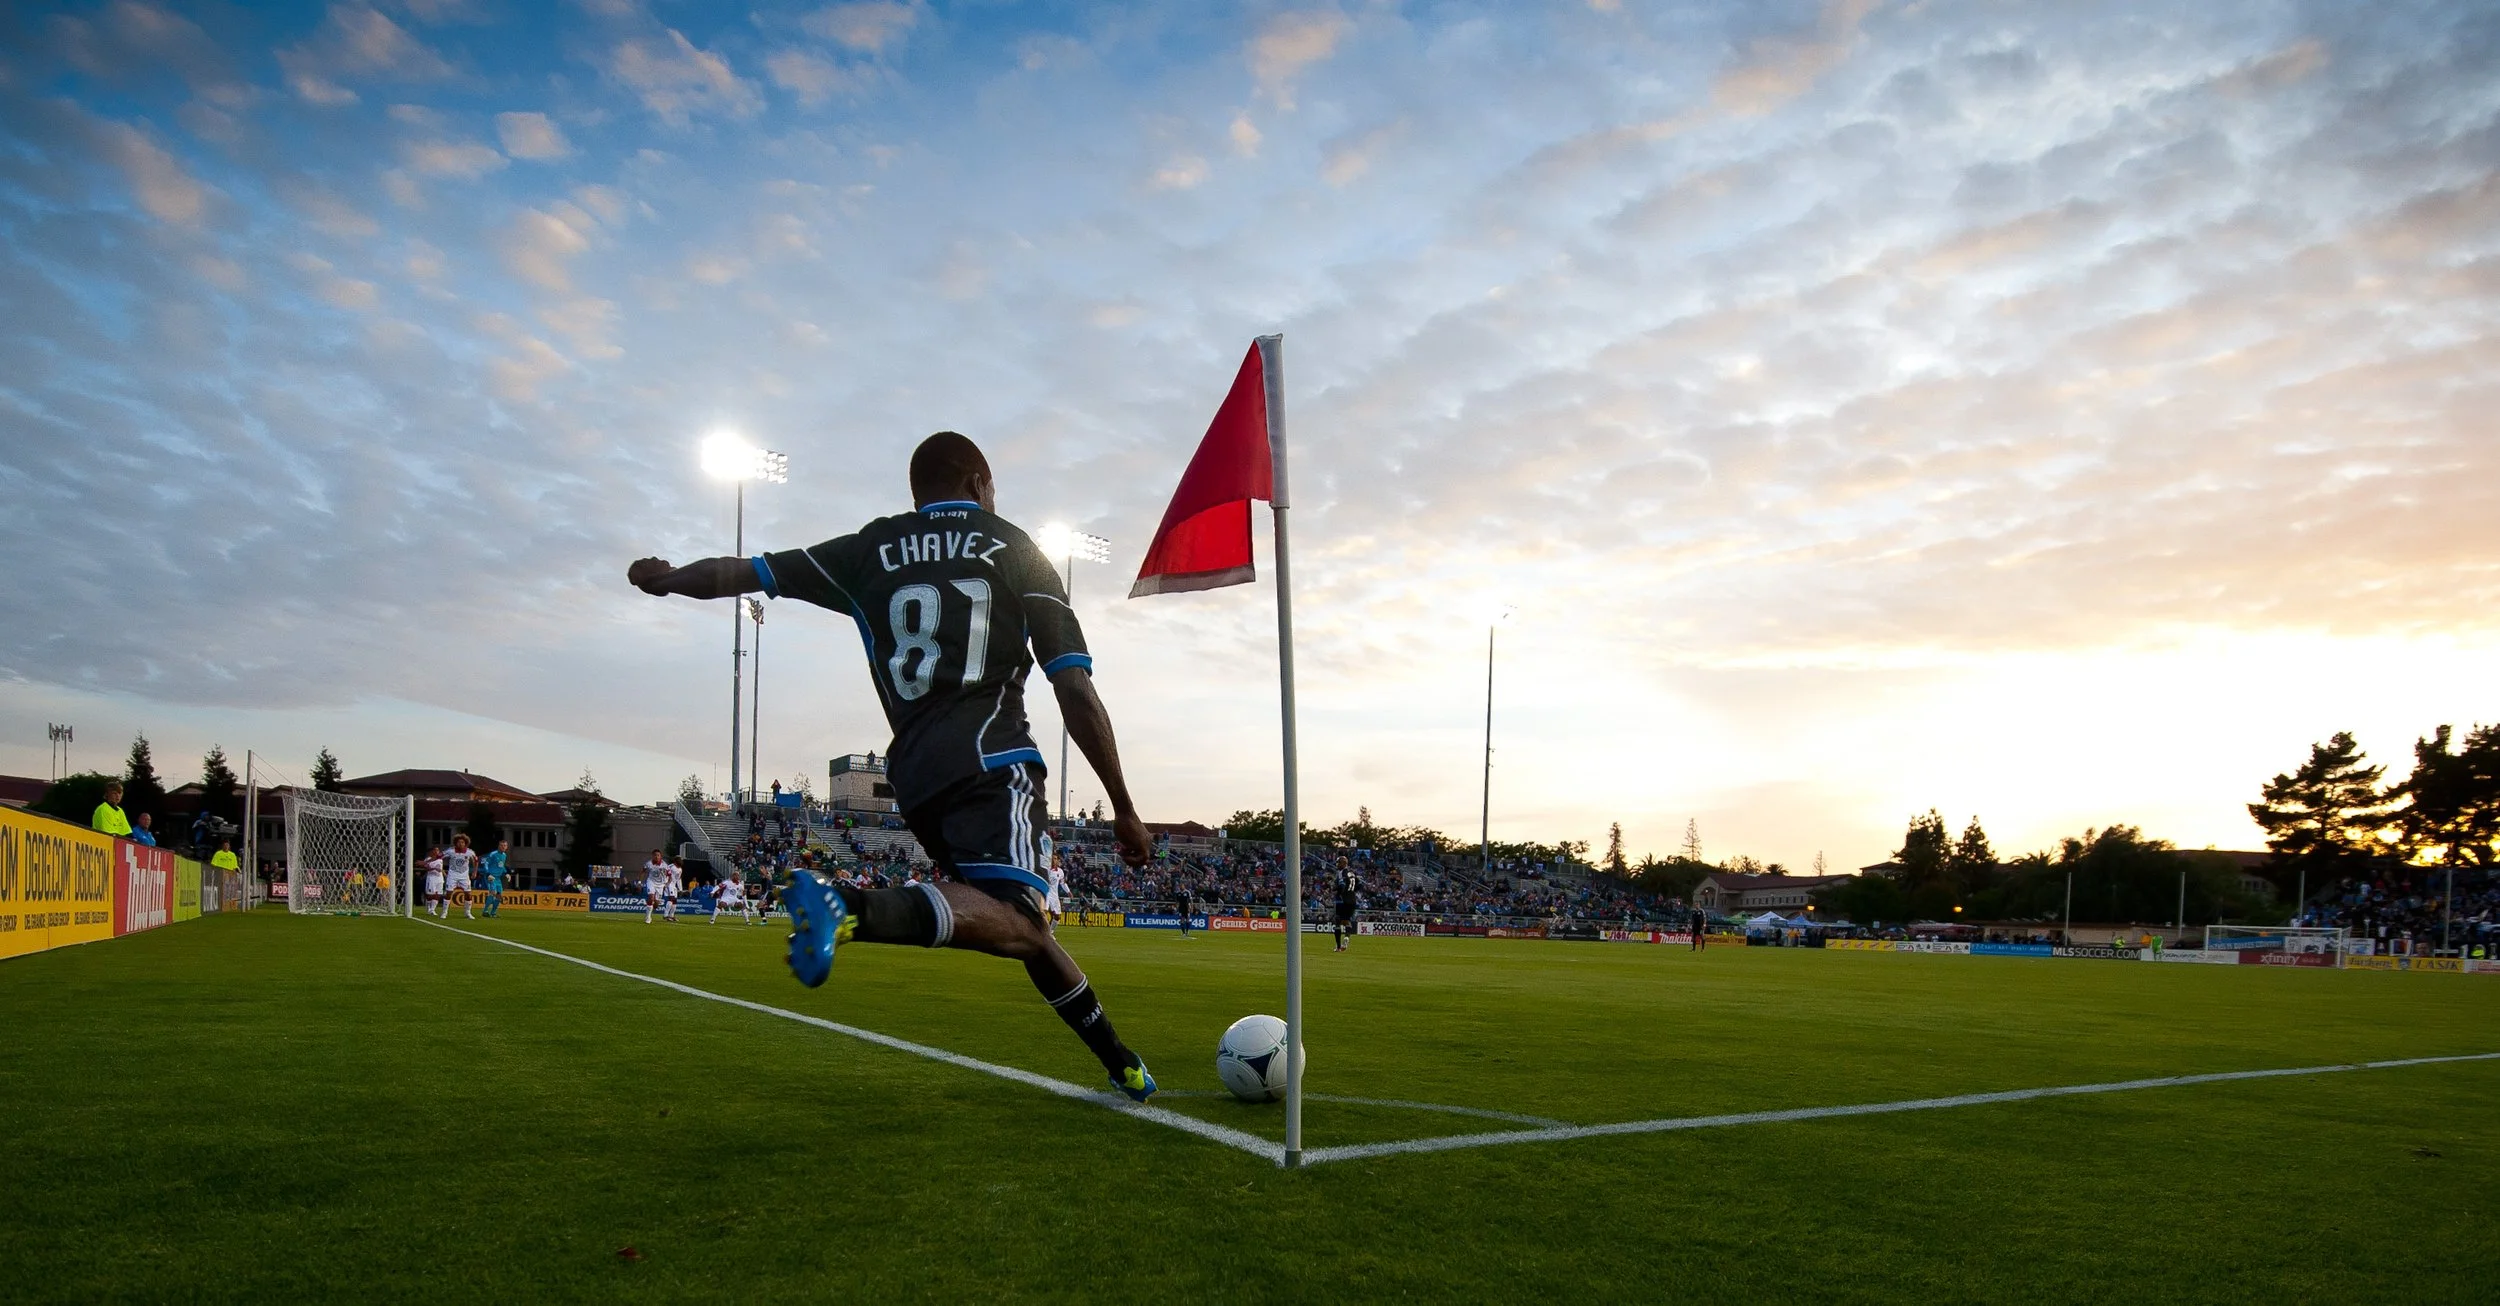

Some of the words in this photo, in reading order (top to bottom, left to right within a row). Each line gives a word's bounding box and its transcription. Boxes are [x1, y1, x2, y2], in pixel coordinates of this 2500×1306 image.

[879, 531, 1007, 572] CHAVEZ
[889, 578, 992, 700] 81
[25, 830, 71, 901] DGDG.COM
[273, 885, 288, 894] POD
[555, 897, 587, 907] TIRE
[2052, 947, 2139, 959] MLSSOCCER.COM
